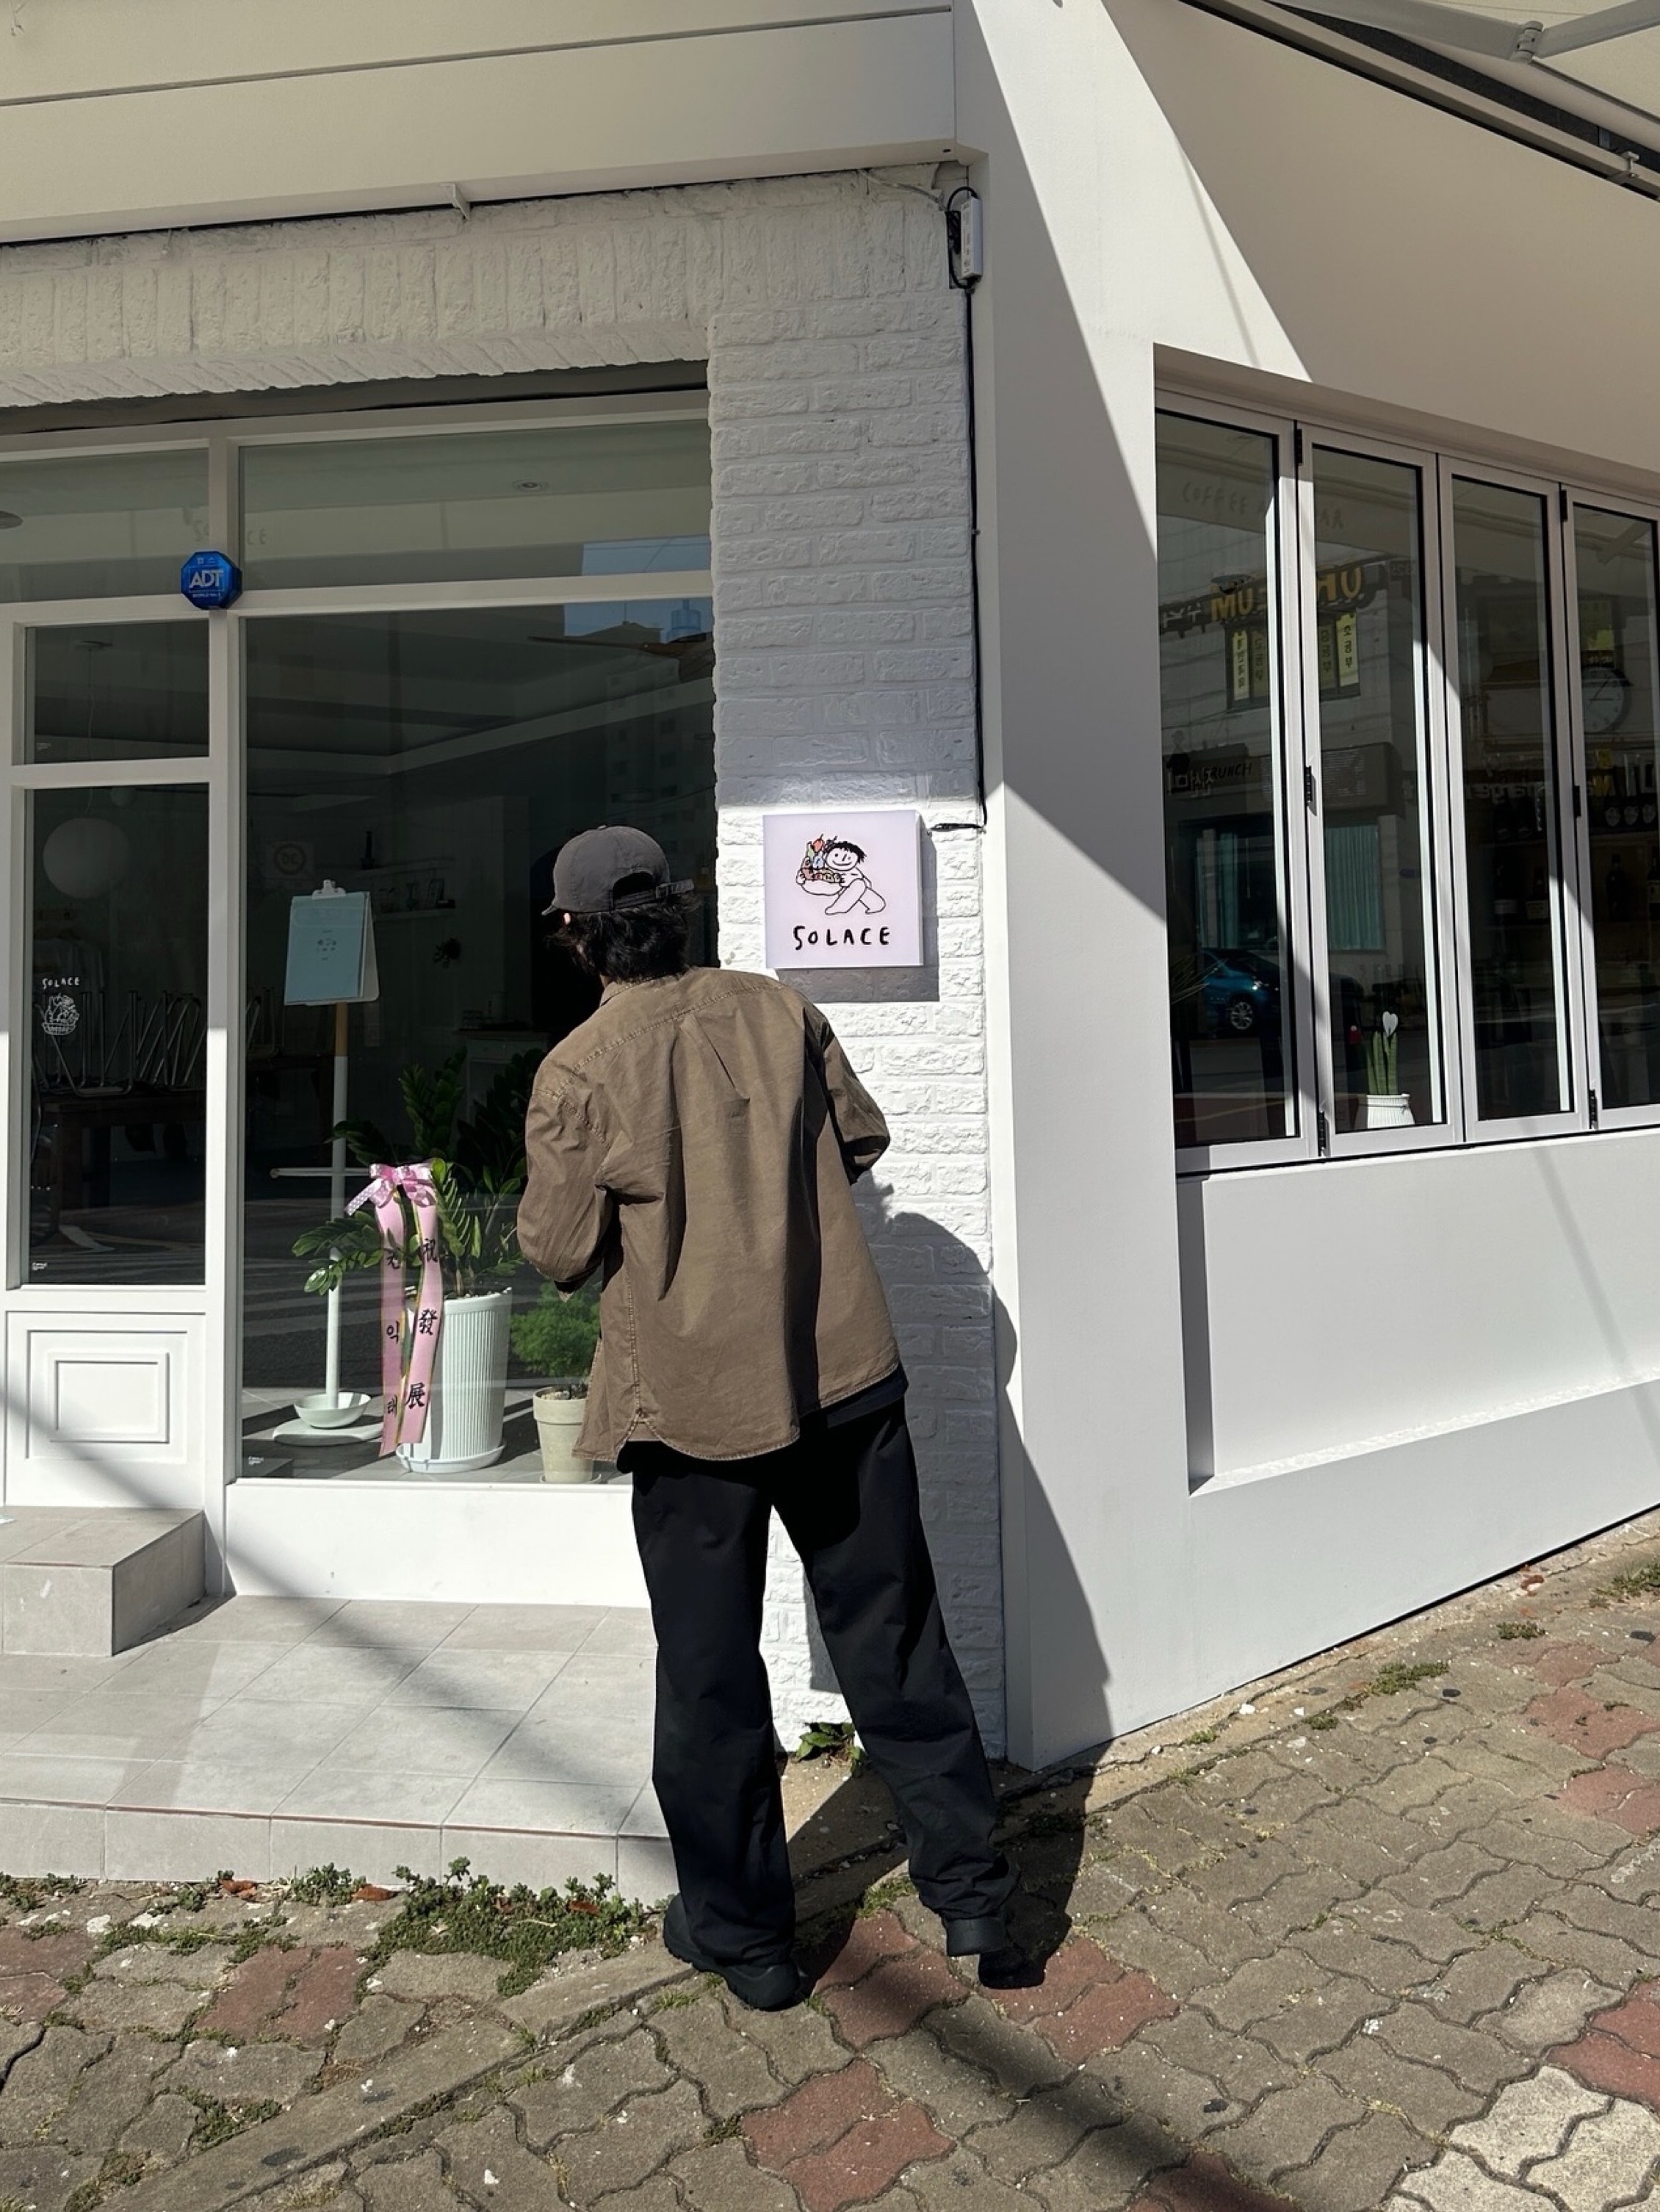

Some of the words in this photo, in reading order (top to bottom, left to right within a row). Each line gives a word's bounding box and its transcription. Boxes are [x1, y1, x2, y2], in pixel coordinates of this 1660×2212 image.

[189, 569, 224, 588] ADT
[793, 925, 891, 951] SOLACE
[42, 976, 80, 990] SOLACE
